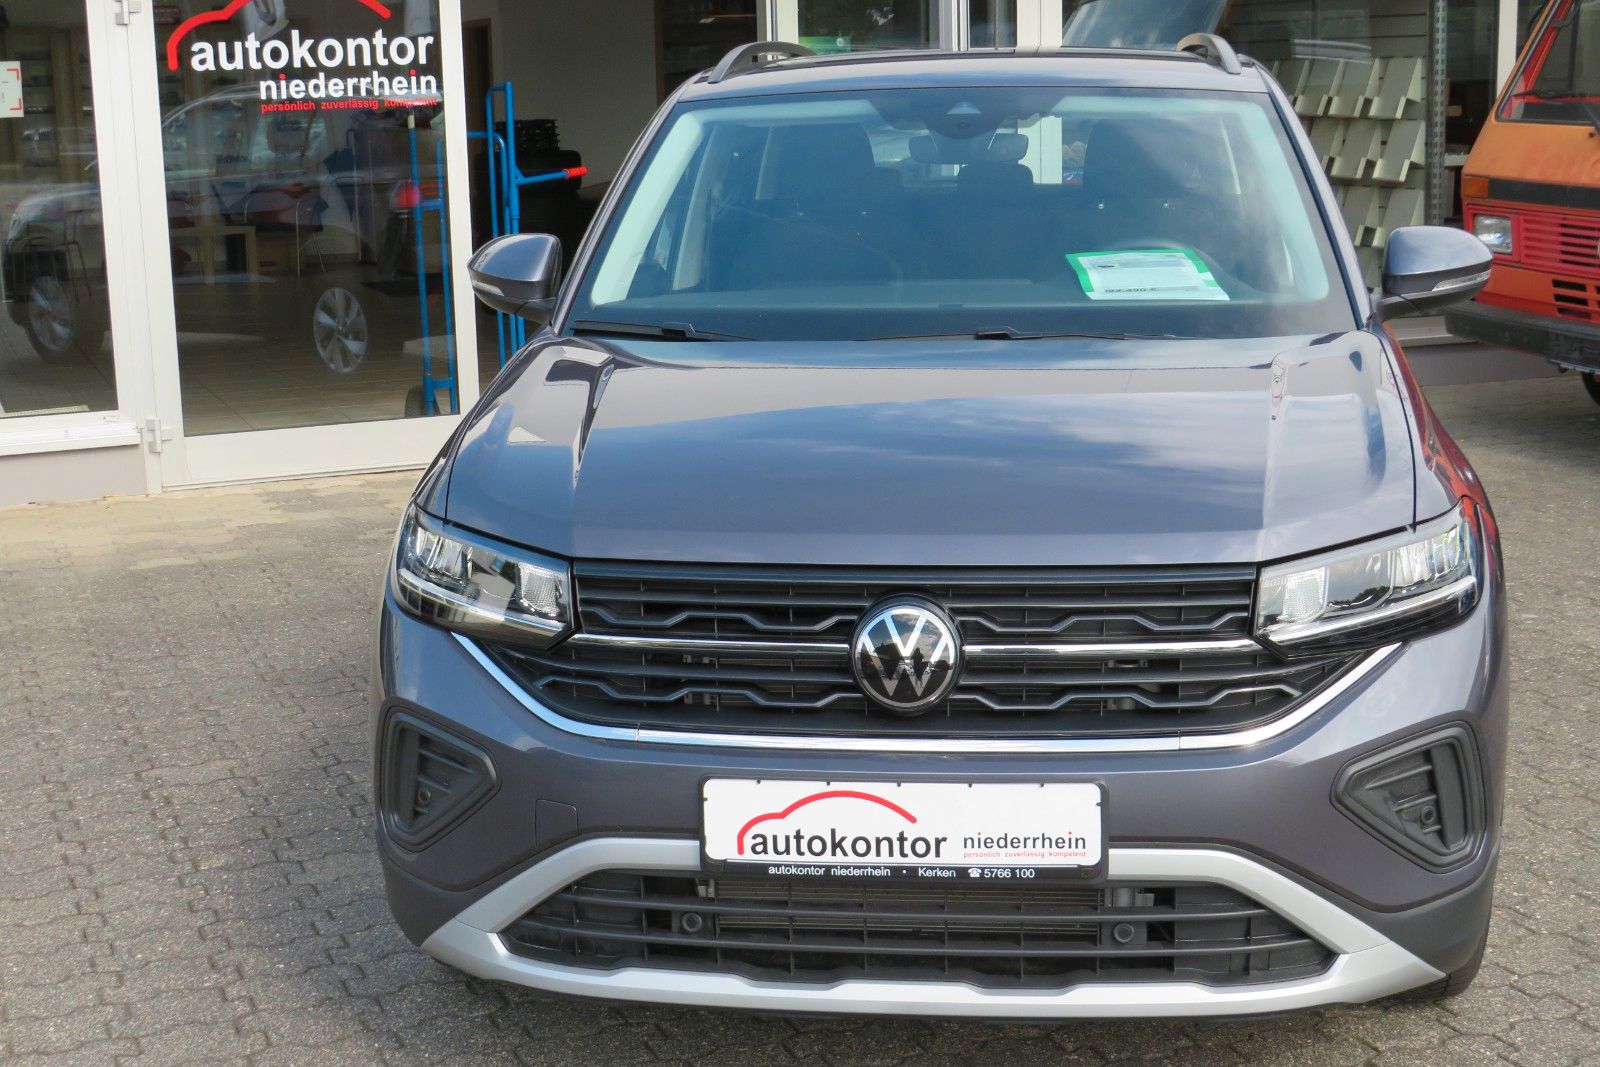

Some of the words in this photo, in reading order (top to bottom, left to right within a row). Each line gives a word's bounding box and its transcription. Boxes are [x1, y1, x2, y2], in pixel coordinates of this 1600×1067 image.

[190, 29, 434, 72] autokontor
[259, 69, 437, 100] niederrhein
[261, 100, 316, 114] persönlich
[320, 98, 380, 111] zuverlässig
[384, 97, 438, 108] kompnt
[750, 828, 947, 858] autokontor
[963, 831, 1086, 850] niederrhein
[768, 865, 825, 876] autokontor
[831, 866, 891, 877] niederrhein
[918, 867, 956, 878] Kerken
[984, 868, 1012, 878] 5766
[1015, 868, 1035, 878] 100
